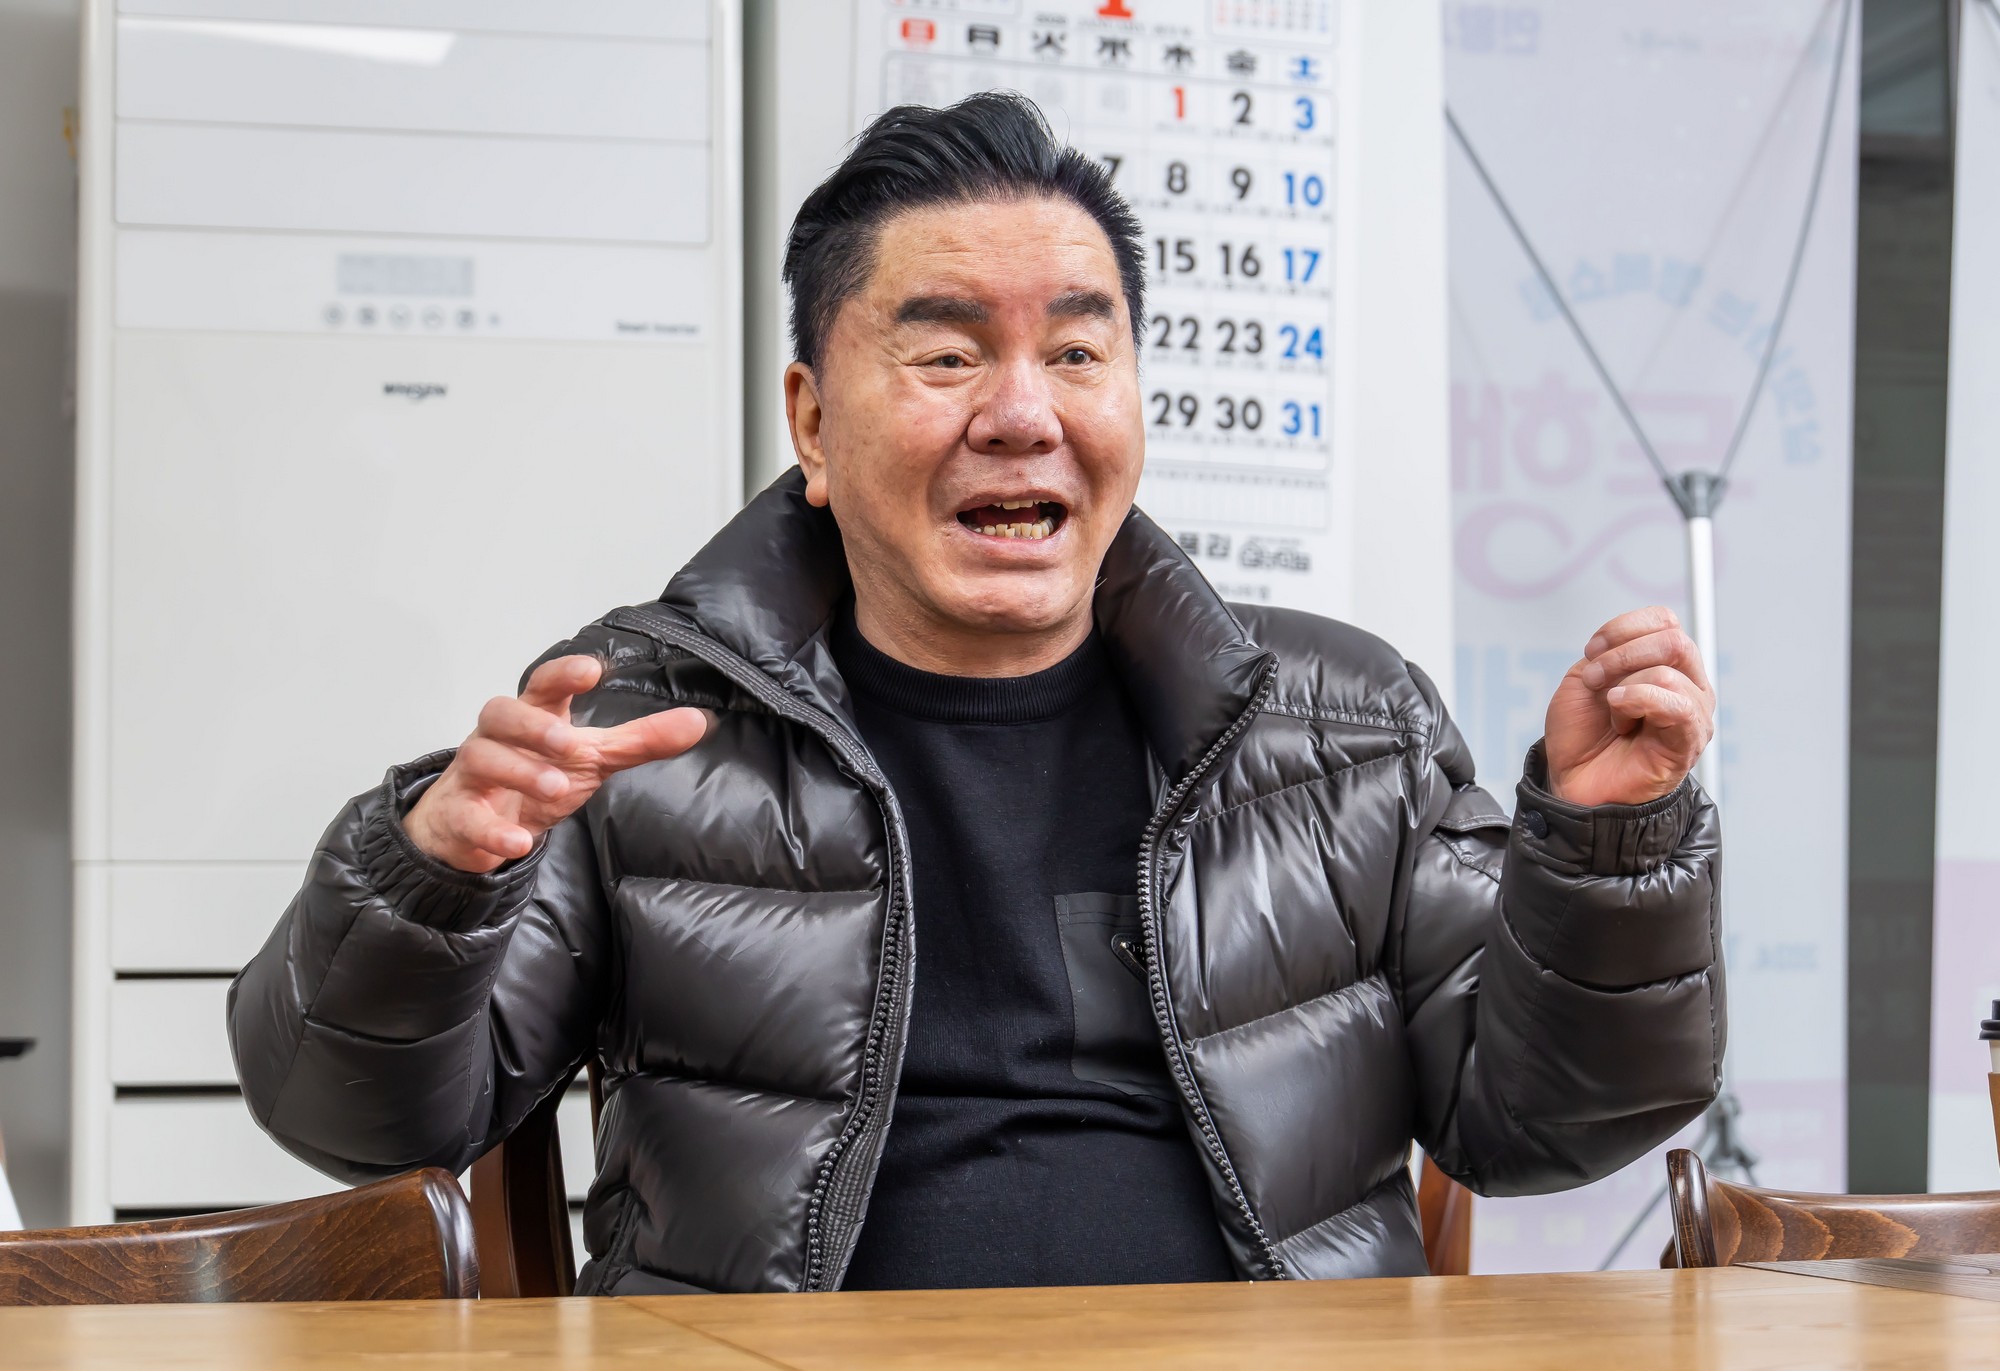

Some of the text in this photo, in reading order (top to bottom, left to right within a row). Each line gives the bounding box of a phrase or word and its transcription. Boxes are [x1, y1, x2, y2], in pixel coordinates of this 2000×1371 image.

[966, 24, 1001, 48] 月
[1032, 32, 1066, 55] 火
[1097, 36, 1131, 62] 水
[1163, 44, 1194, 69] 木
[1226, 49, 1258, 76] 金
[1290, 55, 1320, 81] 土
[1171, 86, 1316, 131] 1 2 3
[1101, 154, 1325, 207] 7 8 9 10
[1155, 238, 1321, 283] 15 16 17
[1152, 314, 1324, 360] 22 23 24
[1151, 391, 1321, 437] 29 30 31
